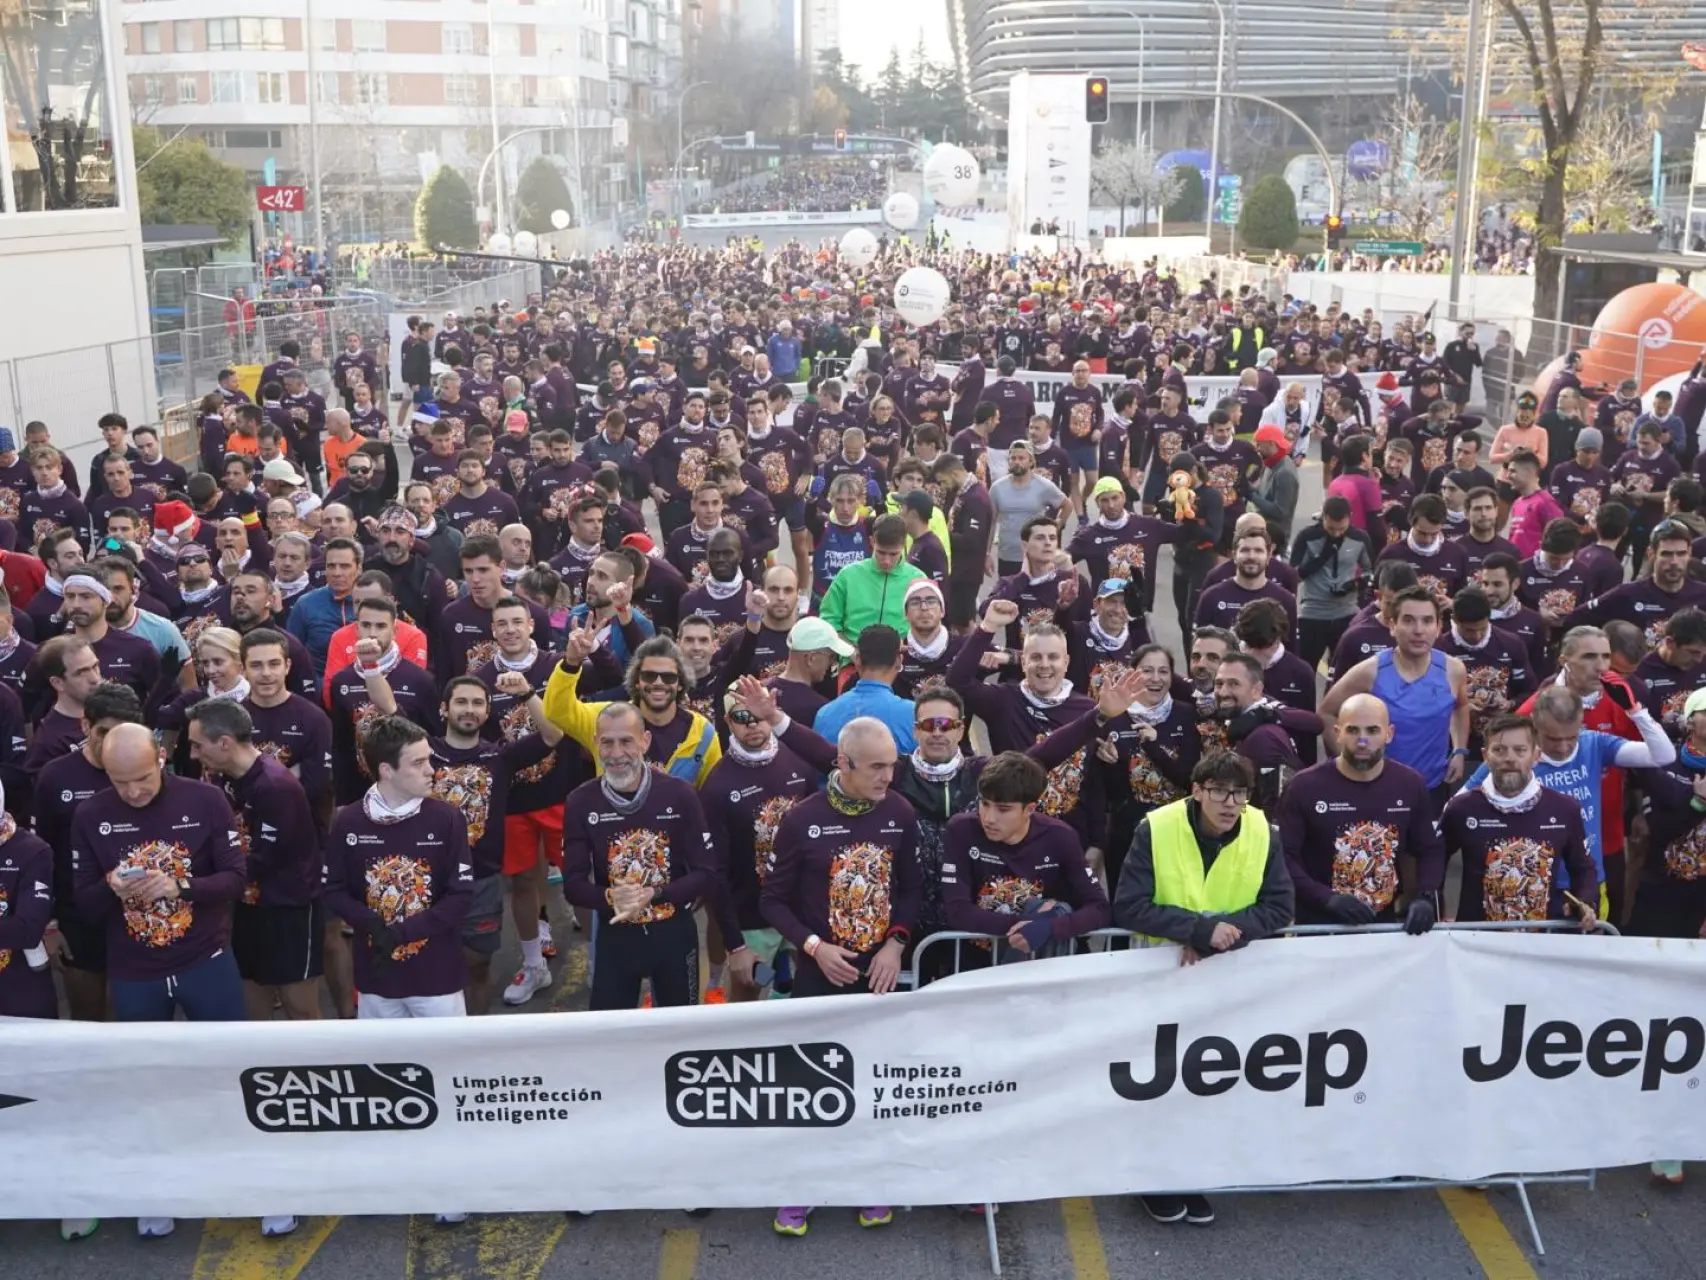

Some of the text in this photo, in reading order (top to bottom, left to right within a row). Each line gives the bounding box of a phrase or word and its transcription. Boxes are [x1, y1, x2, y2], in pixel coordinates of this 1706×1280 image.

[1463, 1004, 1705, 1092] Jeep
[677, 1052, 776, 1084] SANI
[873, 1064, 962, 1081] Limpieza
[1110, 1022, 1368, 1107] Jeep
[252, 1070, 356, 1097] SANI
[452, 1075, 543, 1090] Limpieza
[874, 1080, 1017, 1102] y desinfección
[454, 1088, 602, 1107] y desinfección
[676, 1086, 847, 1121] CENTRO
[256, 1096, 430, 1126] CENTRO
[456, 1107, 569, 1124] inteligente
[873, 1101, 983, 1119] inteligente
